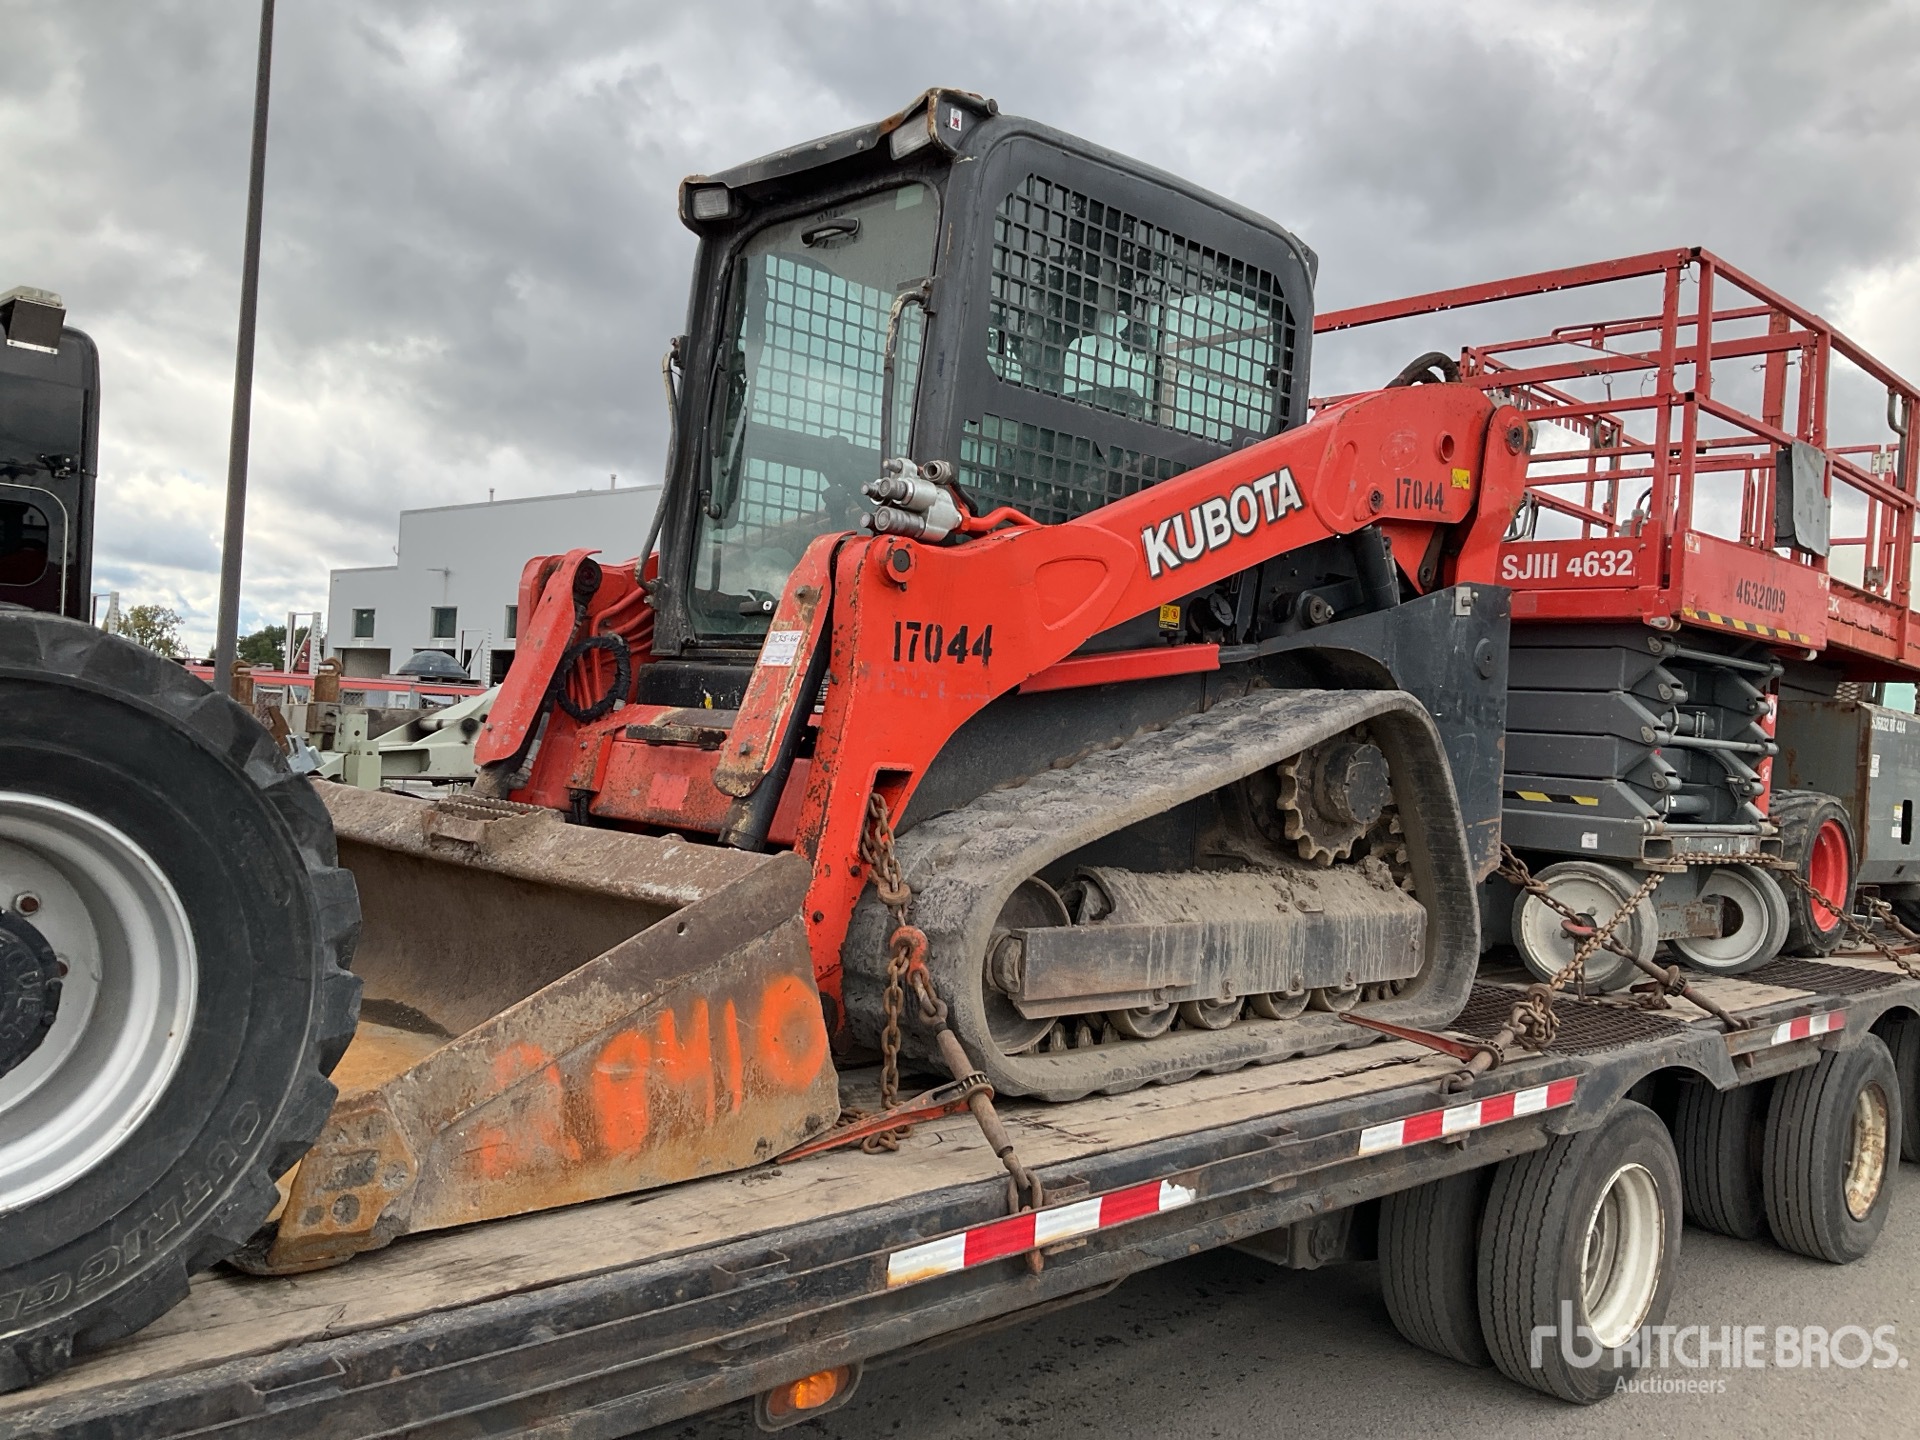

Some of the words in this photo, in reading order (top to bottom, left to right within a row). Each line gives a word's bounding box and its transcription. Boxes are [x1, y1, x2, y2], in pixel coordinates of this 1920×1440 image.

[1396, 477, 1444, 511] 17044
[1141, 465, 1303, 579] KUBOTA
[1566, 549, 1633, 577] 4632
[1736, 577, 1786, 613] 4632009
[893, 621, 993, 668] 17044
